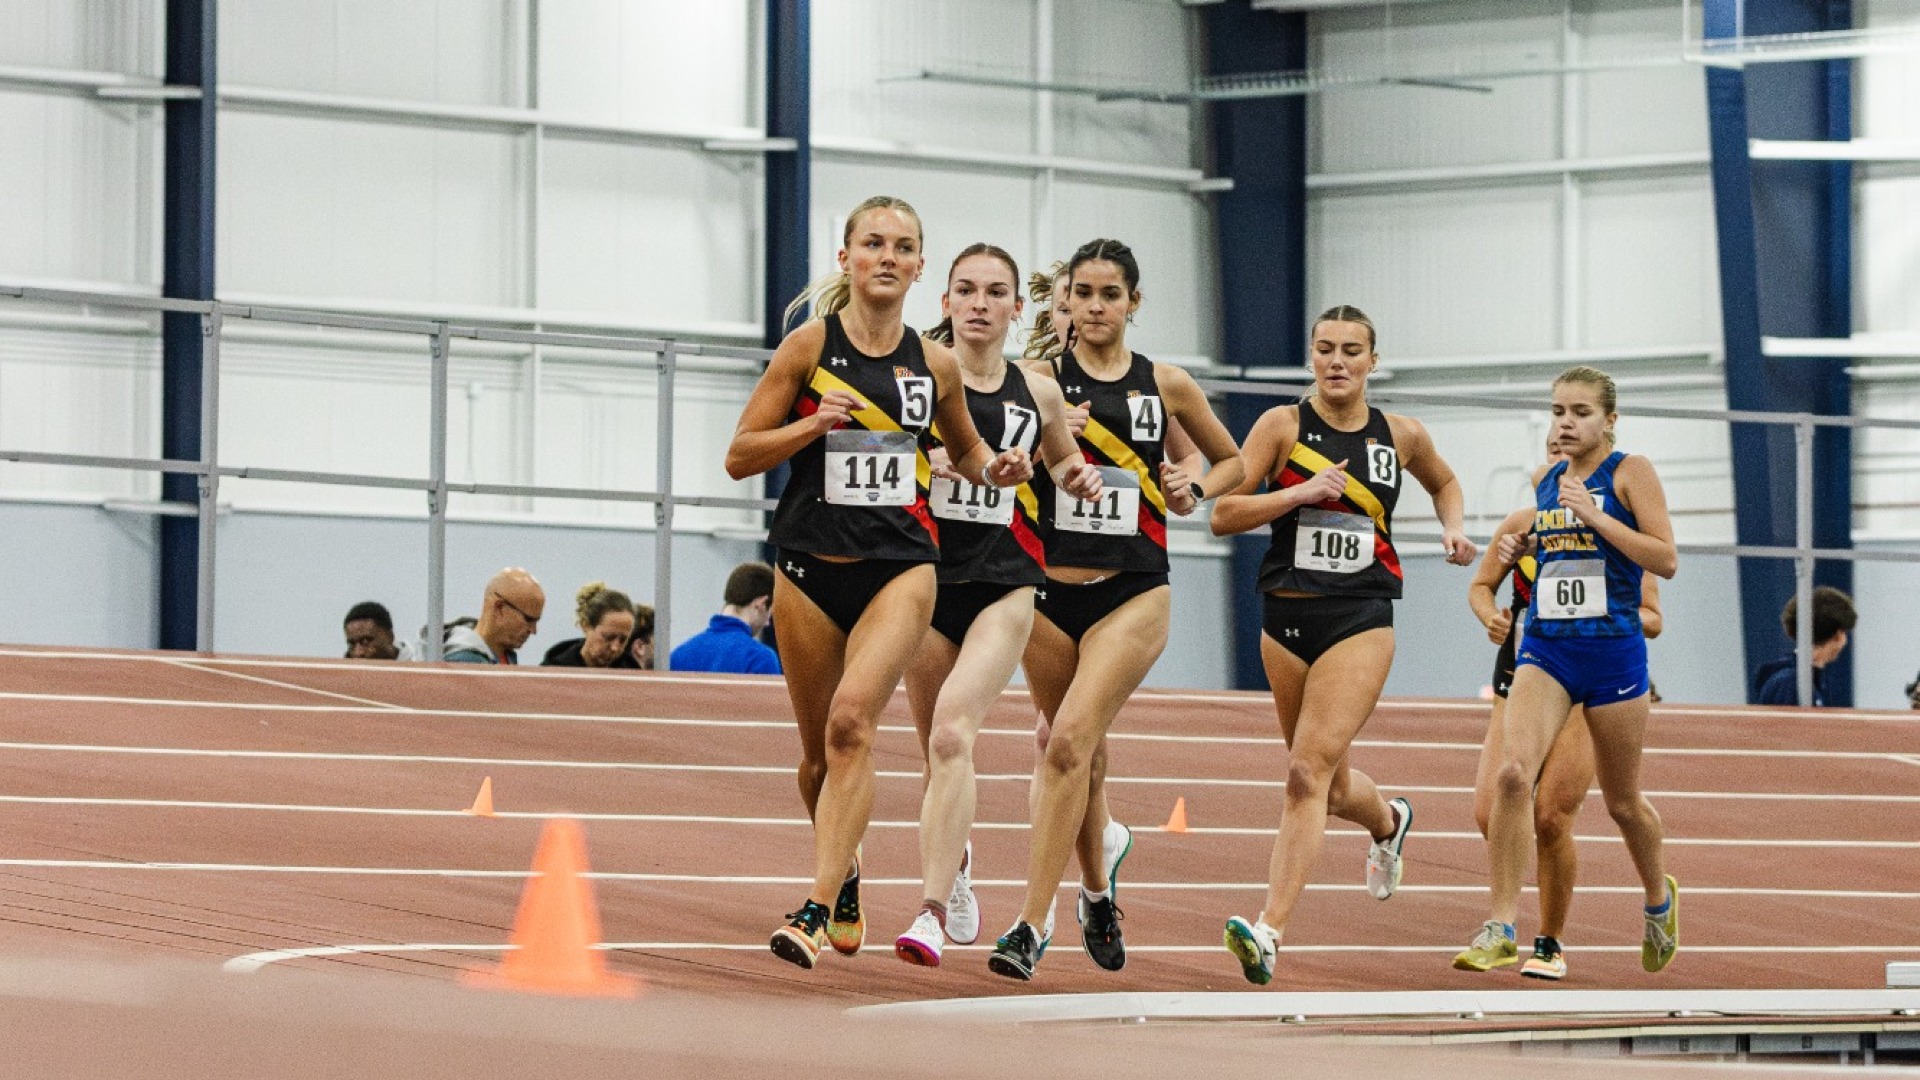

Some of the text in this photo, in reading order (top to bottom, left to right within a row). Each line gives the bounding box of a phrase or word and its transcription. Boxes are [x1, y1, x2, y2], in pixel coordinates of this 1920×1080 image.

[903, 380, 927, 422] 5
[1135, 398, 1157, 438] 4
[1009, 408, 1031, 447] 7
[845, 455, 900, 489] 114
[1373, 447, 1393, 481] 8
[947, 480, 1001, 508] 116
[1311, 530, 1361, 561] 108
[1556, 579, 1585, 606] 60
